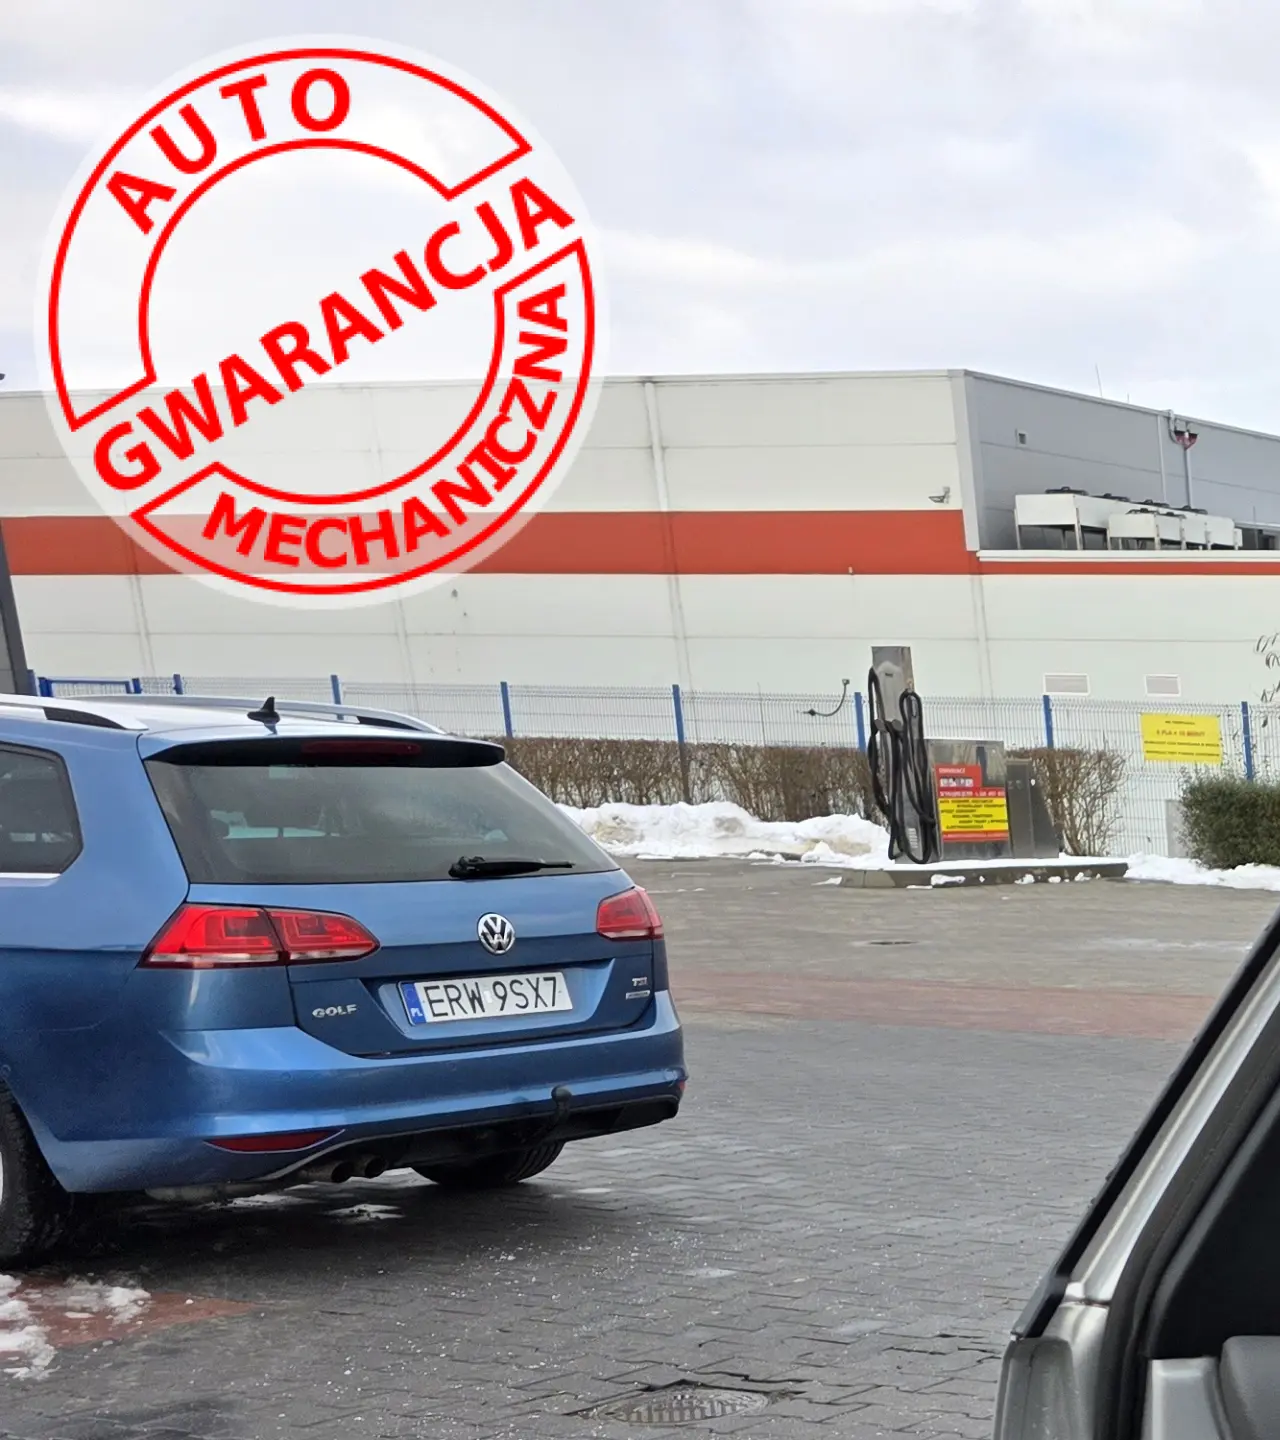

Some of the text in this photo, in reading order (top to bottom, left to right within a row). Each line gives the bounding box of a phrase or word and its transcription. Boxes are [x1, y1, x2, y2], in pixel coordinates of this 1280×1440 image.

[312, 1003, 357, 1018] GOLF
[423, 976, 557, 1018] ERW 9SX7
